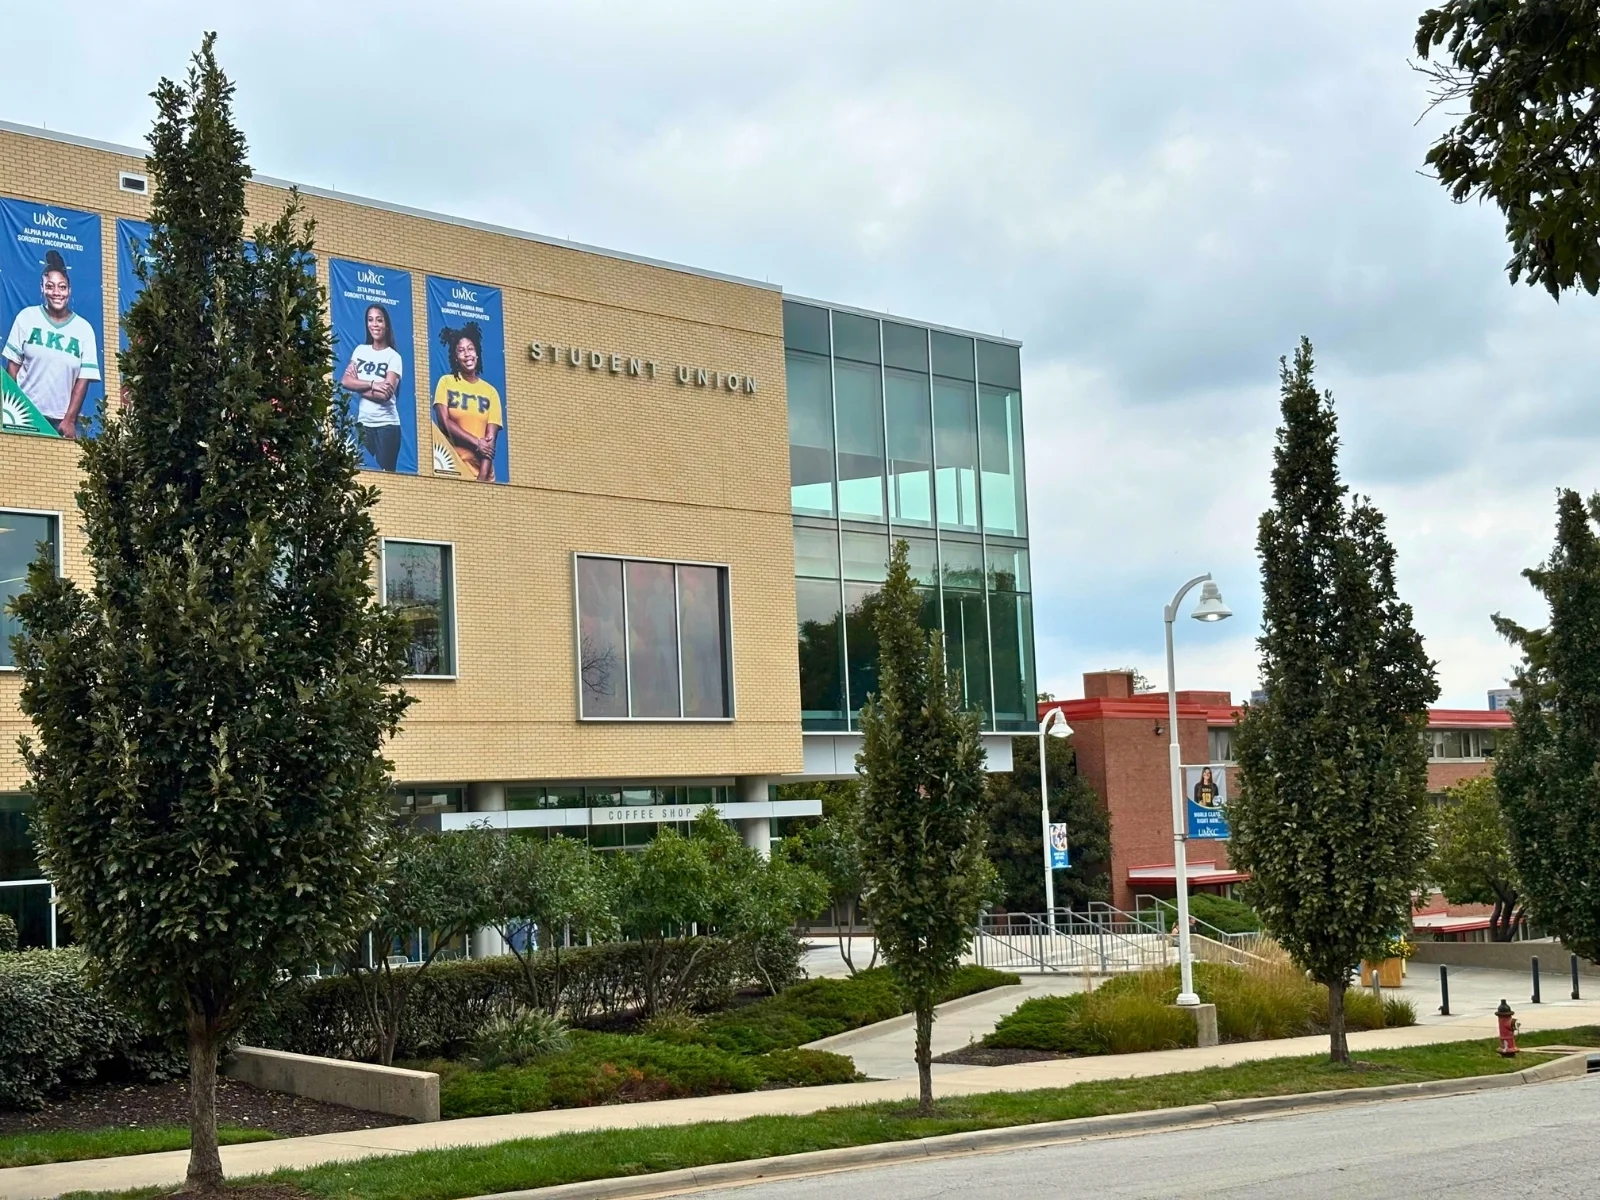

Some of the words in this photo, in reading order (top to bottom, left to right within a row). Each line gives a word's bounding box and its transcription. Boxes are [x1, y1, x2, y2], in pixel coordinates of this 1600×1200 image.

[33, 211, 68, 230] UMKC
[17, 234, 45, 246] SORORITY,
[44, 239, 84, 252] INCORPORATED
[24, 227, 41, 236] ALPHA
[42, 230, 59, 240] KAPPA
[60, 233, 77, 243] ALPHA
[357, 270, 385, 286] UMKC
[376, 289, 387, 297] BETA
[452, 287, 478, 302] UMKC
[461, 310, 490, 321] INCORPORATED
[27, 327, 80, 358] AKA
[530, 340, 659, 379] STUDENT
[677, 364, 758, 394] UNION
[608, 809, 654, 821] COFFEE
[662, 807, 692, 818] SHOP
[1198, 827, 1219, 837] UMKC
